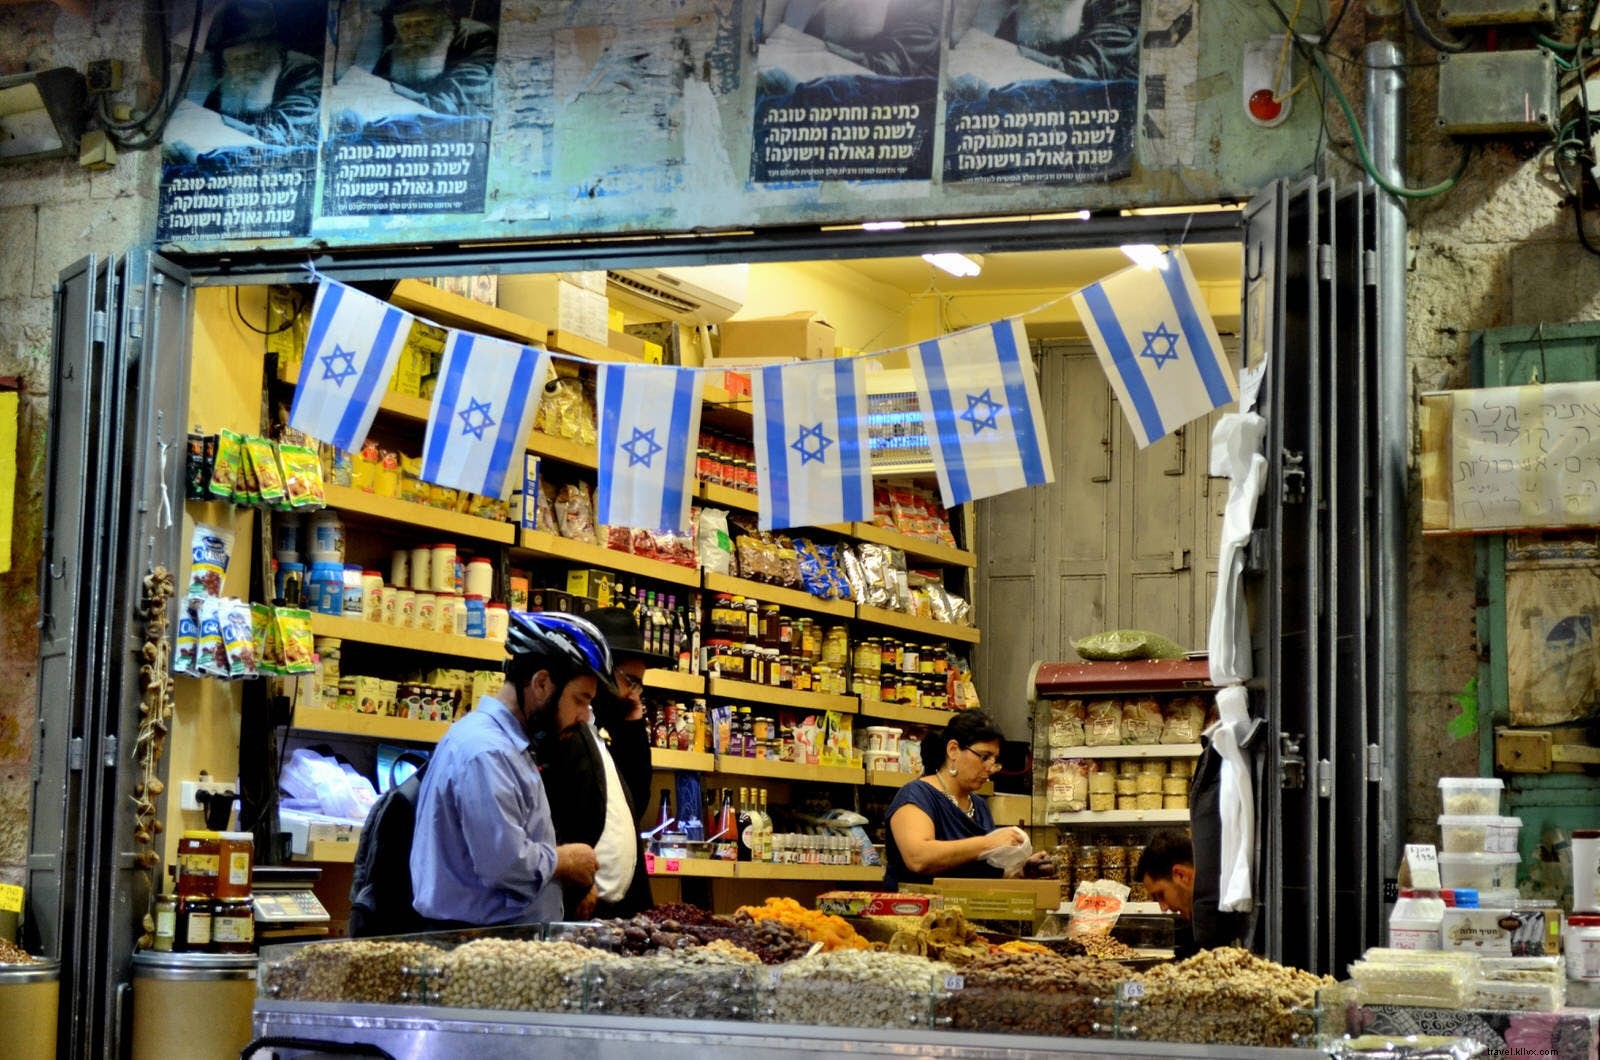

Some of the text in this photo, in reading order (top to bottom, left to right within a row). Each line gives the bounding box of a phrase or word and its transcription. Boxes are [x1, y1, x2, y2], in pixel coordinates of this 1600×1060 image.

[763, 104, 920, 125] כתיבה וחתימה טובה,
[955, 109, 1120, 131] כתיבה וחתימה טובה,
[765, 121, 916, 145] לשנה טובה ומתוקה,
[958, 126, 1116, 152] לשנה טובה ומתוקה,
[335, 142, 475, 162] כתיבה וחתימה טובה,
[765, 143, 913, 162] שנת גאולה וישועה!
[958, 149, 1113, 170] שנת גאולה וישועה!
[336, 158, 470, 181] לשנה טובה ומתוקה,
[168, 172, 302, 193] כתיבה וחתימה טובה,
[335, 179, 468, 197] שנת גאולה וישועה!
[226, 193, 259, 207] טובה
[262, 187, 298, 205] לשנה
[169, 209, 295, 228] שנת גאולה וישועה!
